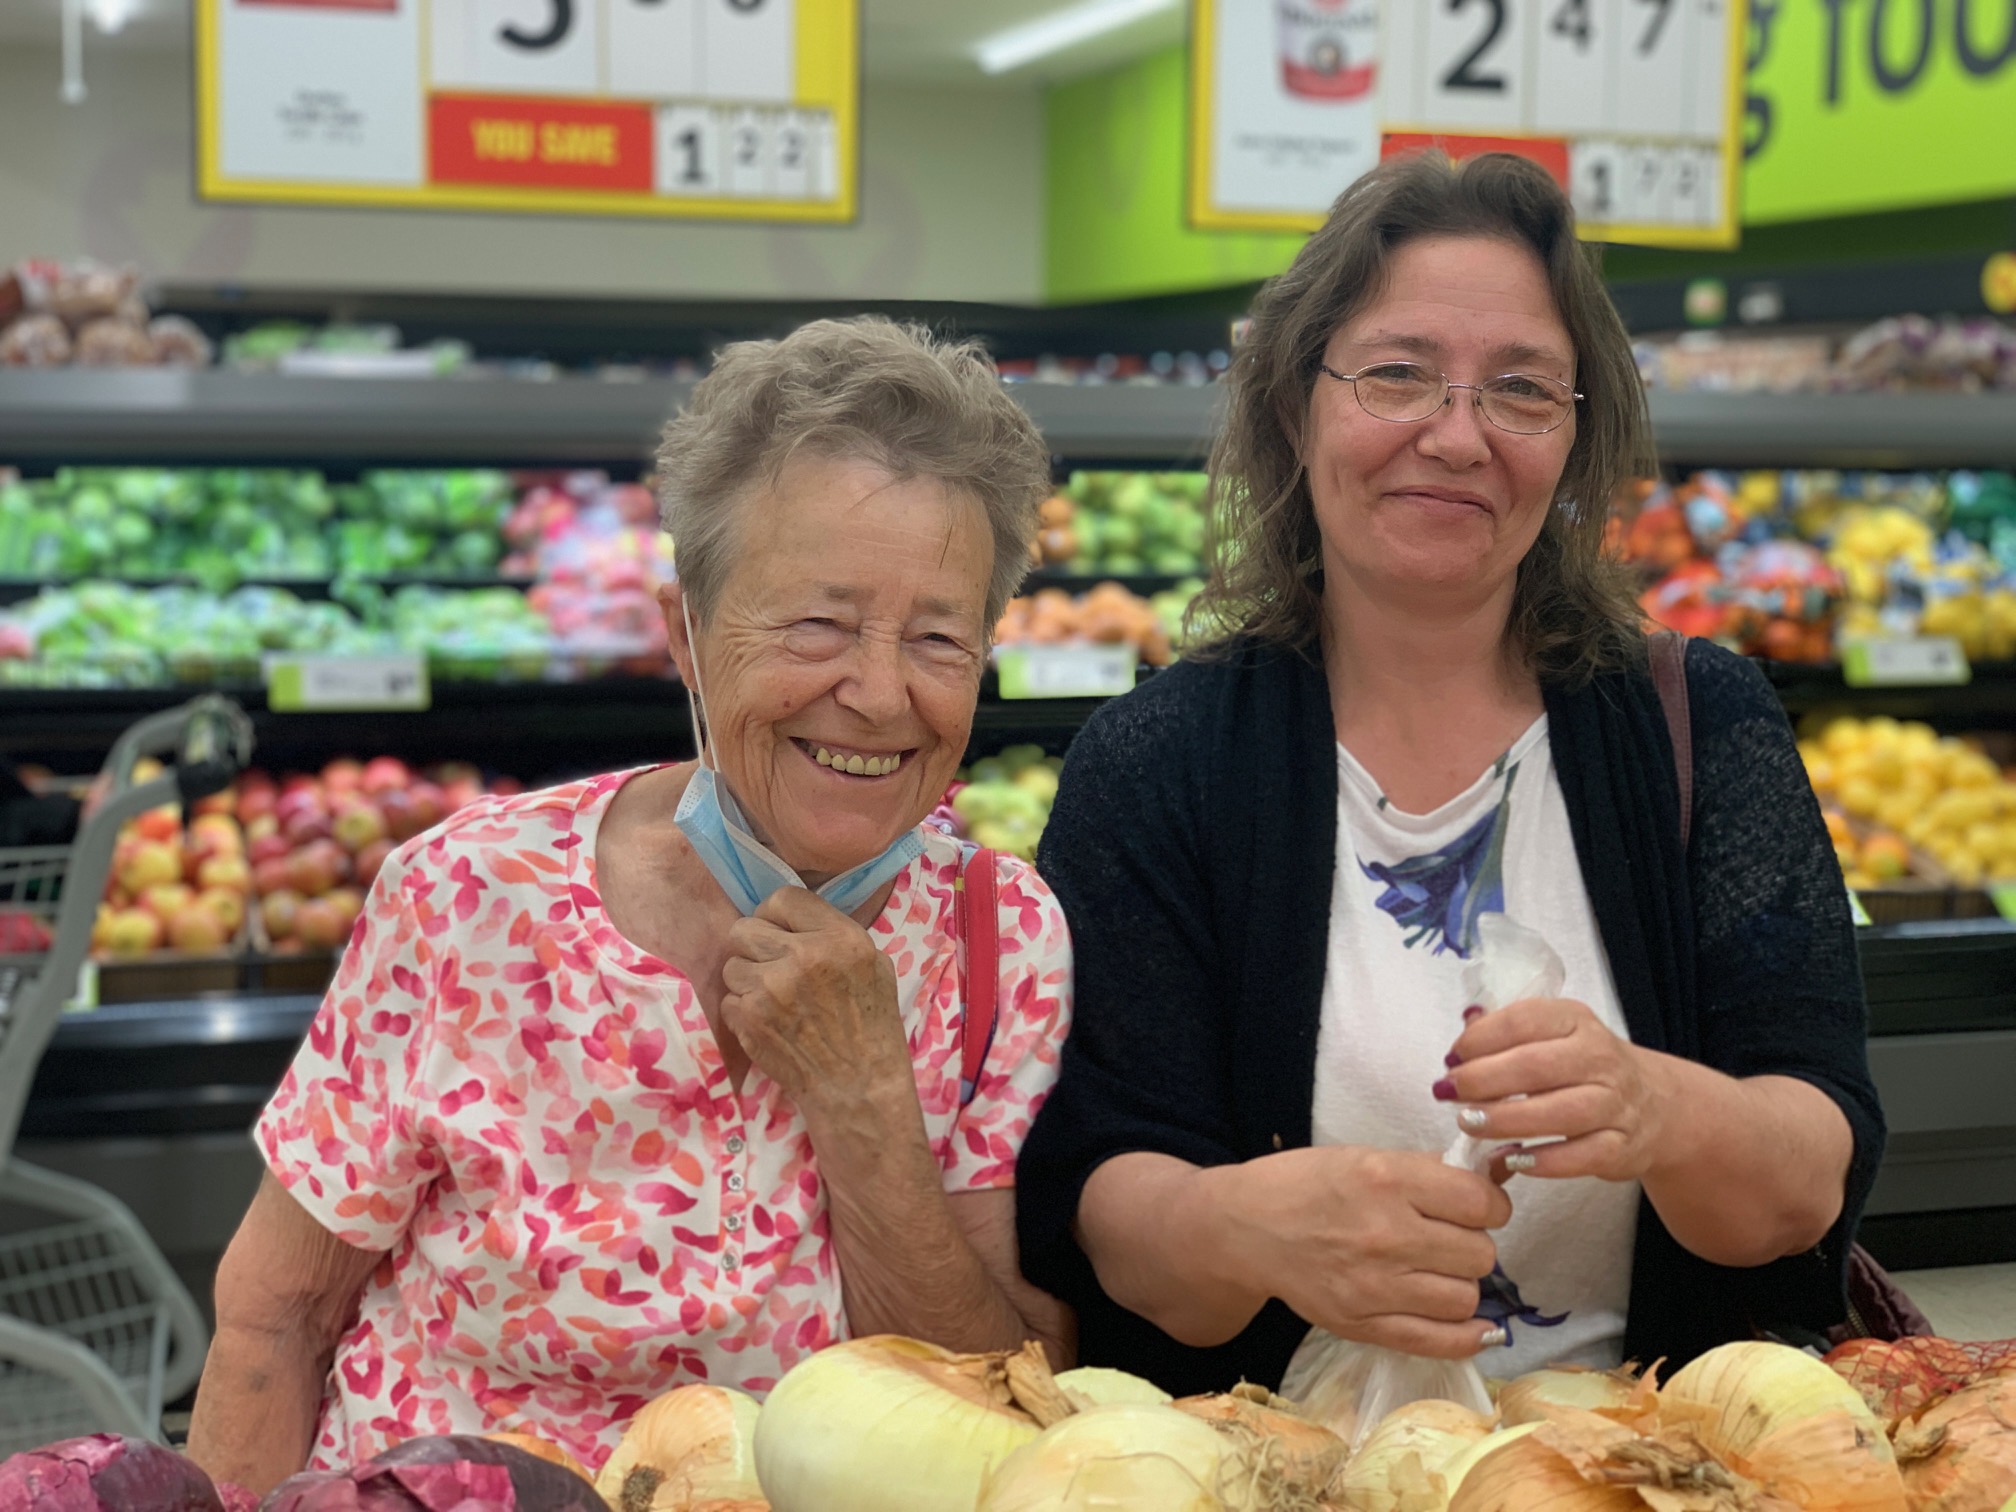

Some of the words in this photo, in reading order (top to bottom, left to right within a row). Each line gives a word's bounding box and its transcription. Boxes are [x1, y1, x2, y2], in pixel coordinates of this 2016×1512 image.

[1441, 0, 1507, 93] 2
[471, 119, 535, 162] YOU
[539, 121, 620, 168] SAVE
[672, 127, 711, 184] 1
